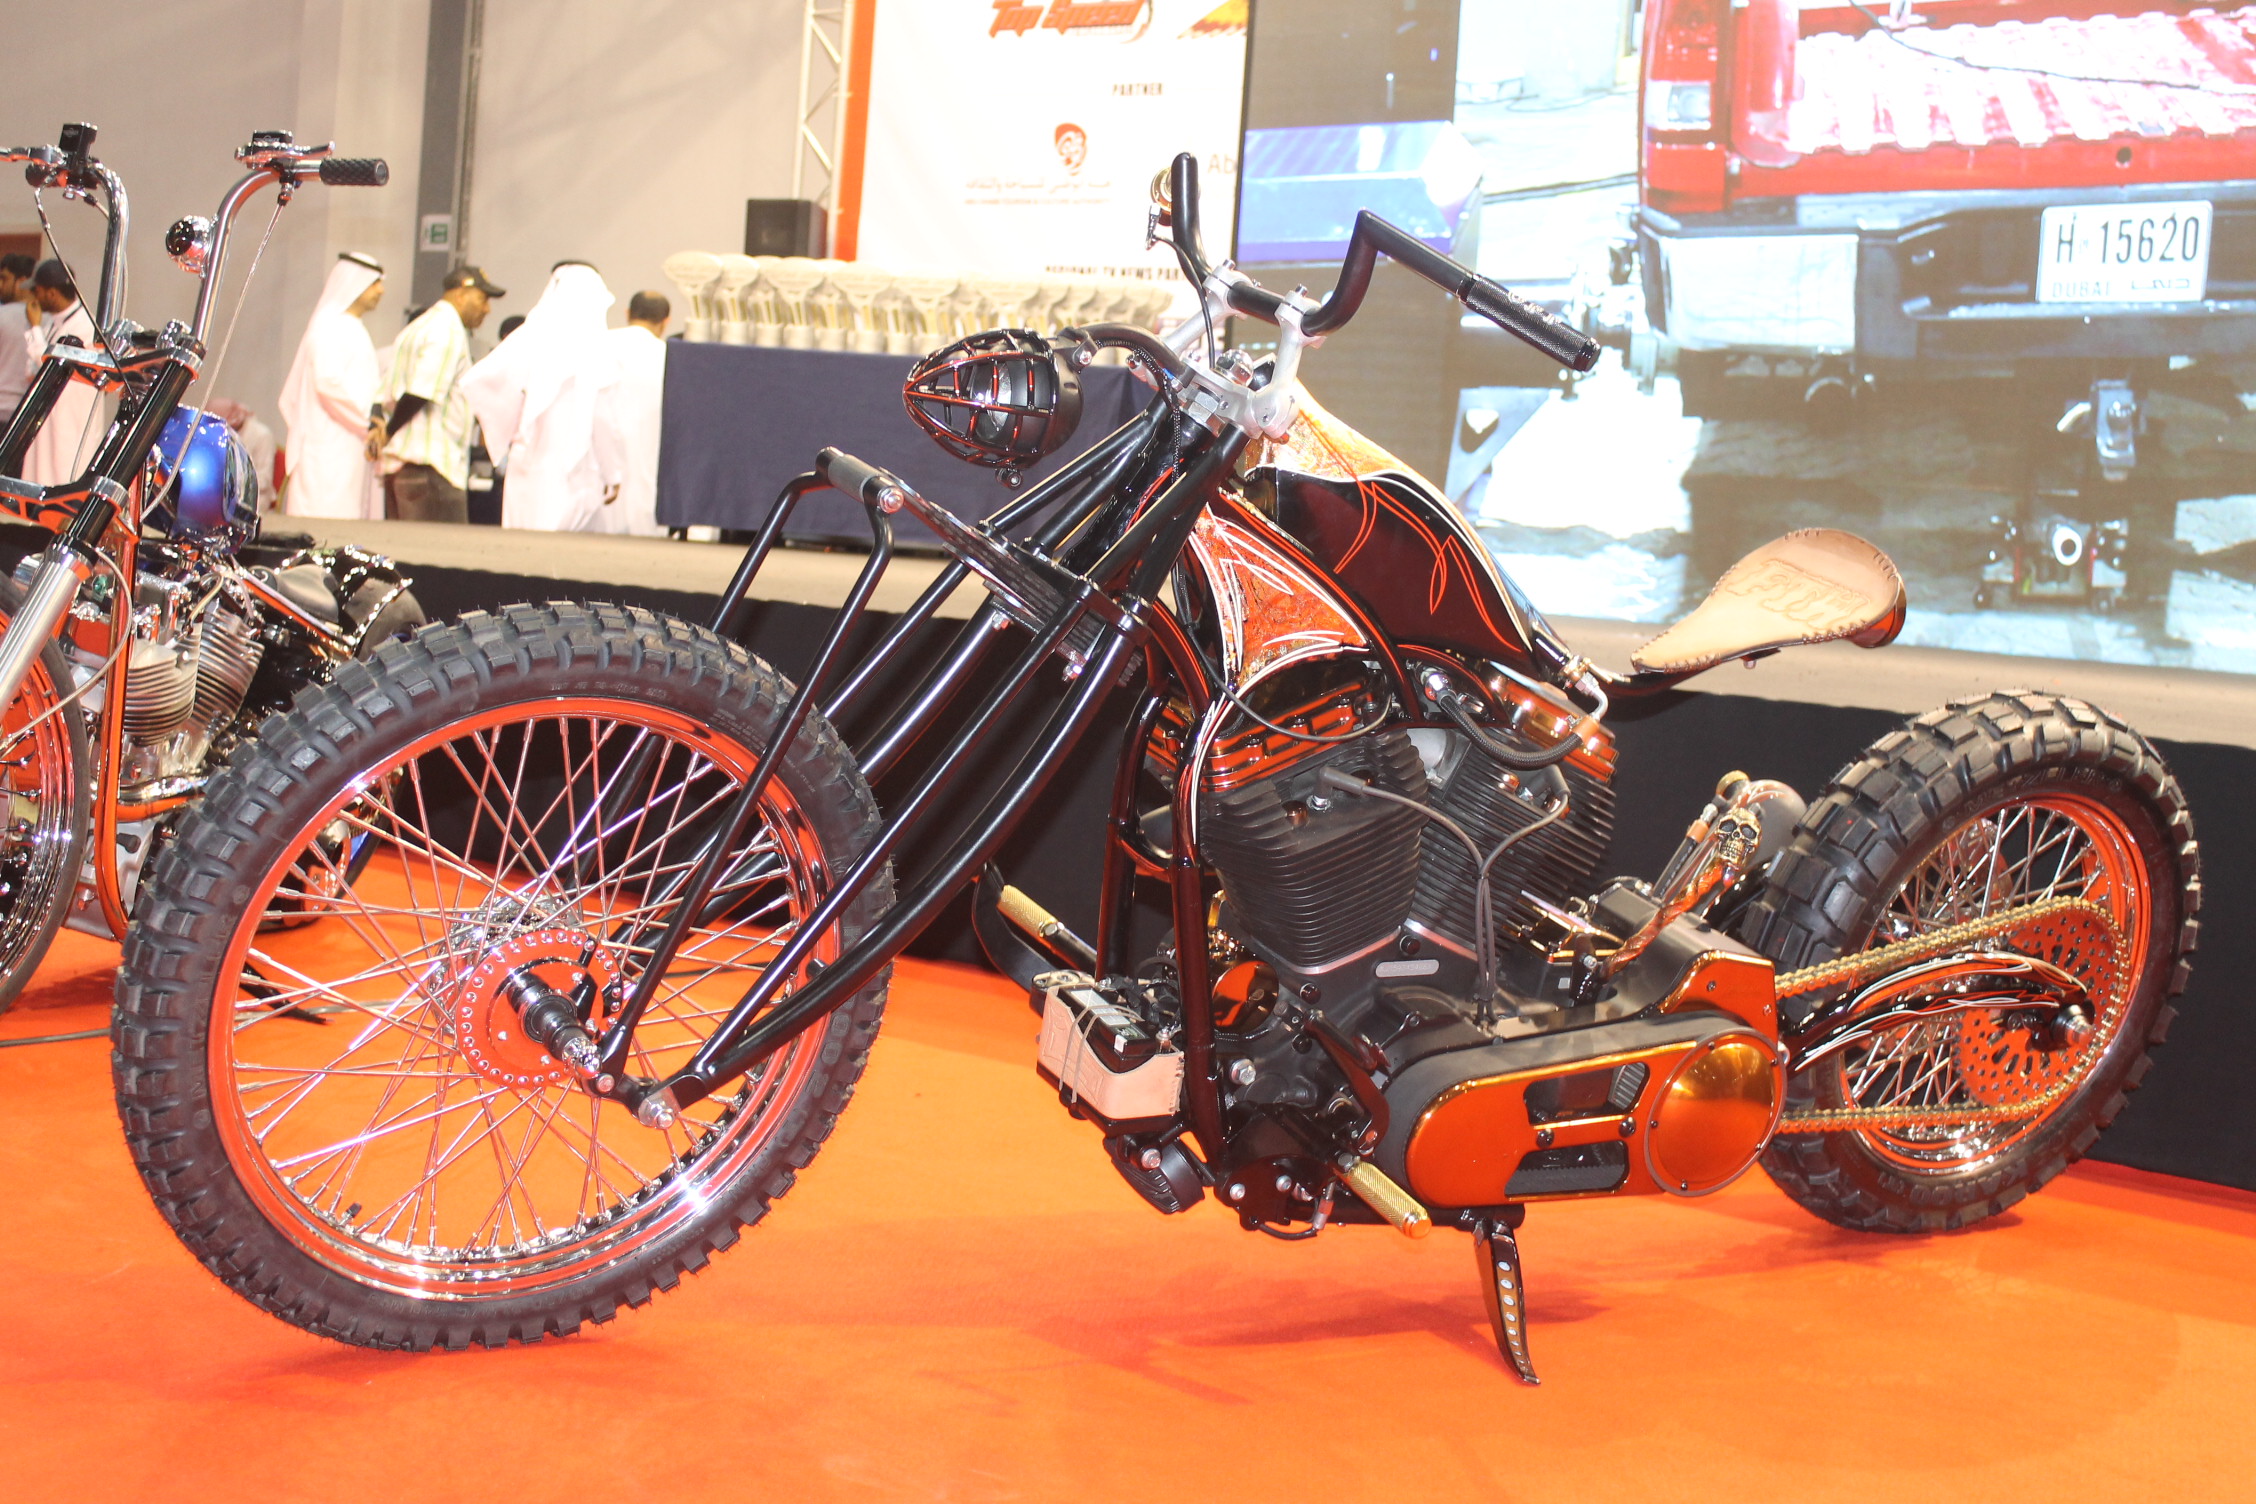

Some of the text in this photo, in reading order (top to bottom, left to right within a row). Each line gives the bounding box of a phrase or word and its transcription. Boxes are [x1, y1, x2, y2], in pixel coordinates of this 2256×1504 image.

[988, 0, 1145, 39] Top Speed
[1111, 82, 1163, 96] PARTNER
[2056, 215, 2200, 264] H 15620
[2052, 281, 2111, 298] DUBAI
